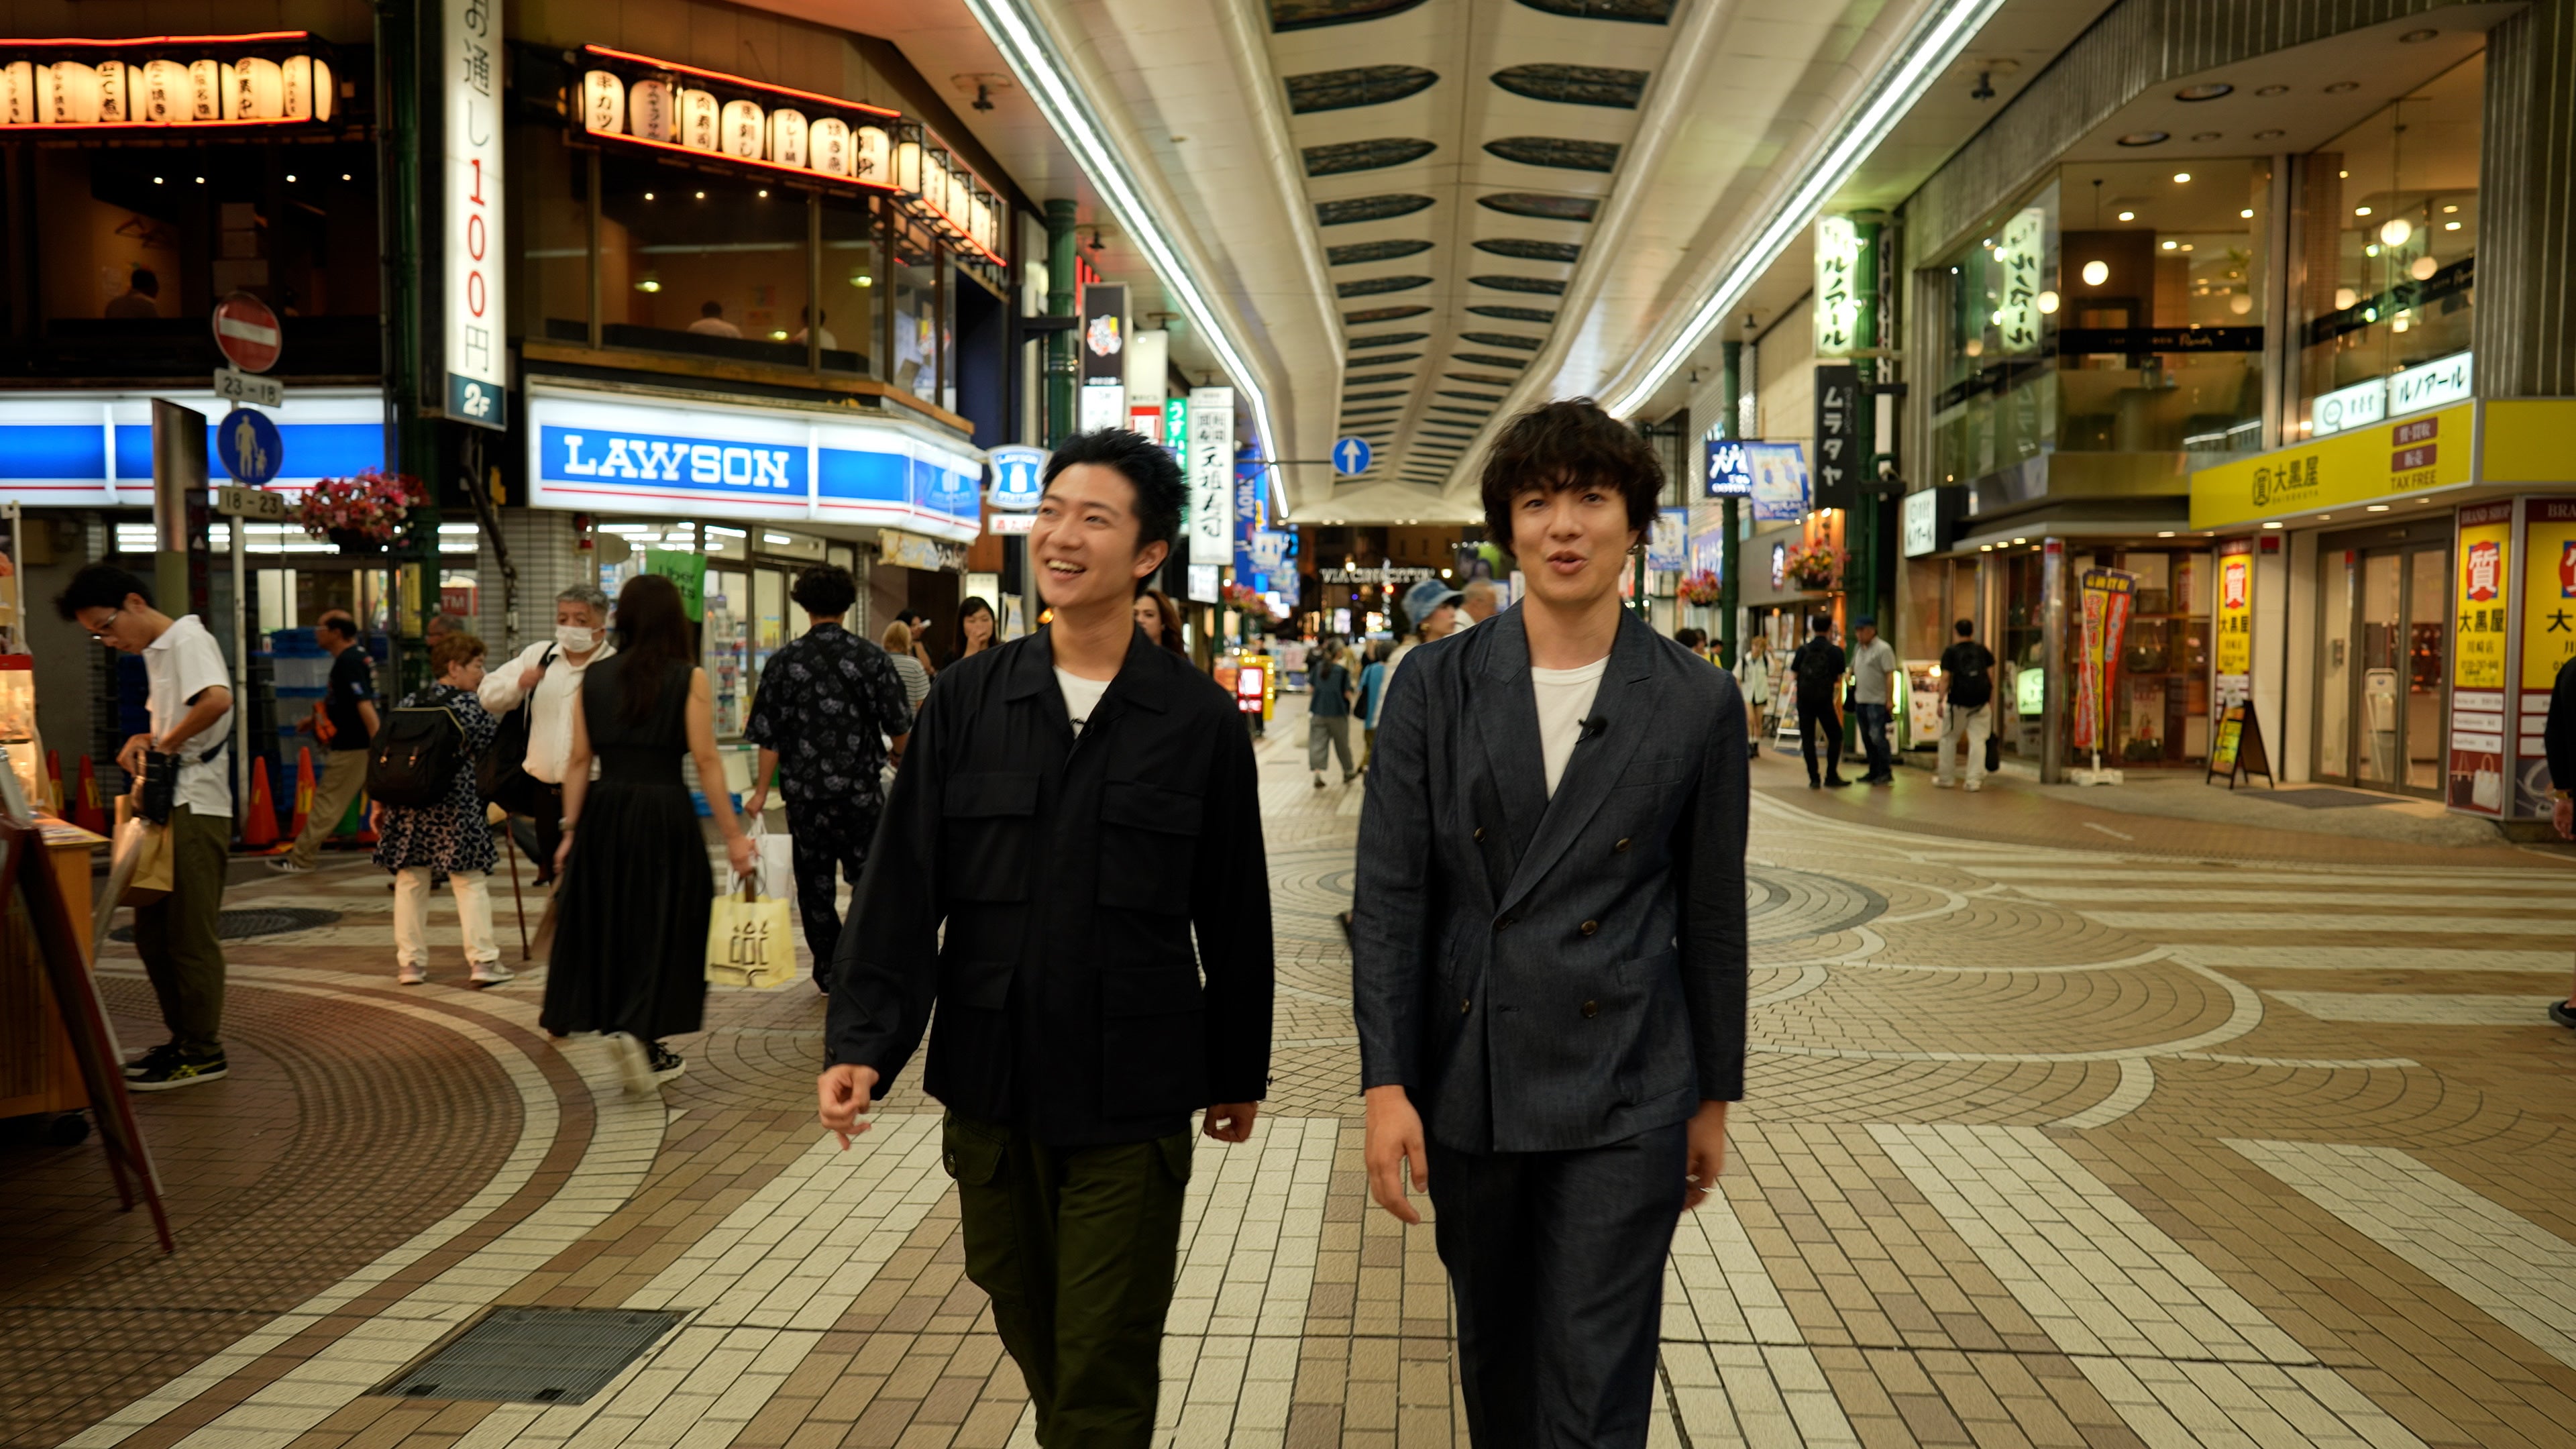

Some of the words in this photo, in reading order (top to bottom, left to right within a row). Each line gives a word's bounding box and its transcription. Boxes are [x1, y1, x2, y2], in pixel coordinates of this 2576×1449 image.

[596, 75, 613, 128] 串カツ
[463, 383, 491, 417] 2F
[2400, 365, 2466, 404] ルノアール
[1822, 386, 1843, 487] ムラタヤ
[564, 434, 790, 488] LAWSON
[2390, 475, 2410, 492] TAX
[2412, 469, 2436, 486] FREE
[2469, 548, 2500, 595] 質
[441, 595, 465, 608] TM
[2459, 608, 2505, 633] 大黒屋
